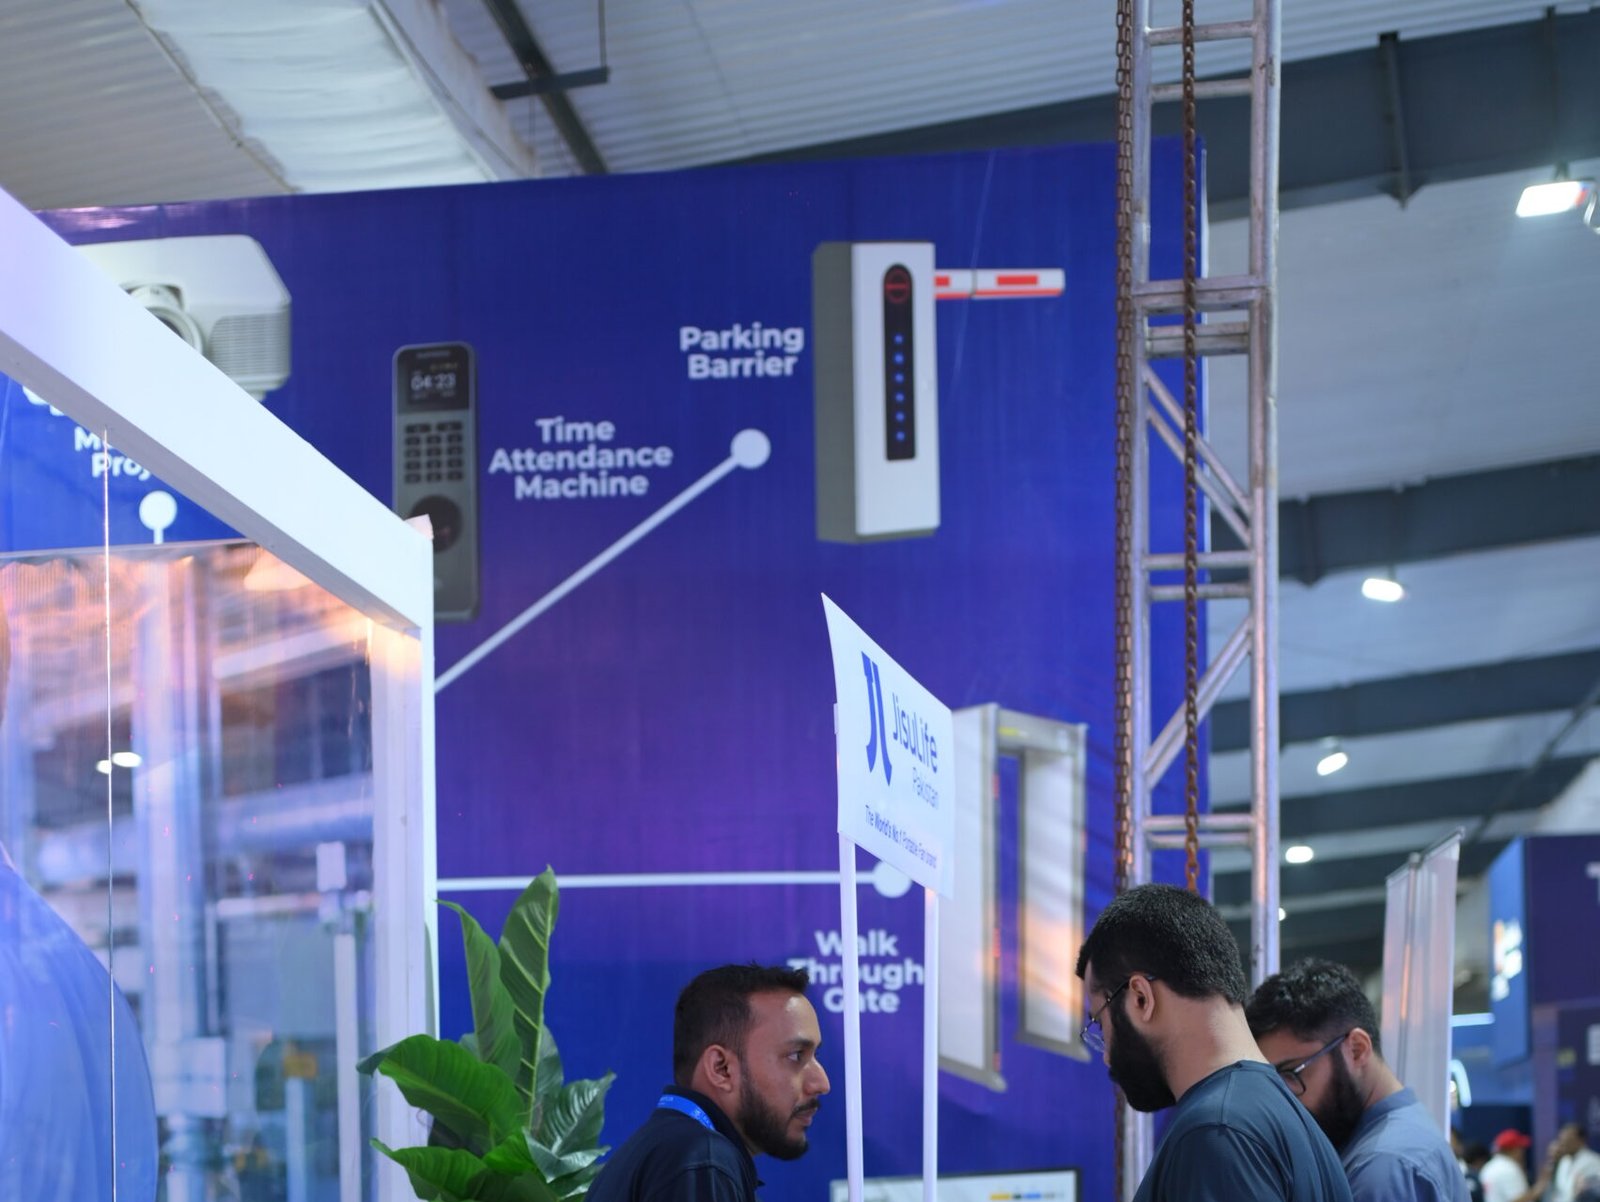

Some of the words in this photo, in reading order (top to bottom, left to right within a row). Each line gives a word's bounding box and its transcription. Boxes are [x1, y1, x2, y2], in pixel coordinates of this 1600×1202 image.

[679, 322, 804, 353] Parking
[688, 350, 798, 379] Barrier
[535, 415, 616, 443] Time
[488, 444, 673, 474] Attendance
[514, 471, 649, 500] Machine
[892, 692, 938, 774] JisuLife
[786, 957, 926, 991] Thrugh
